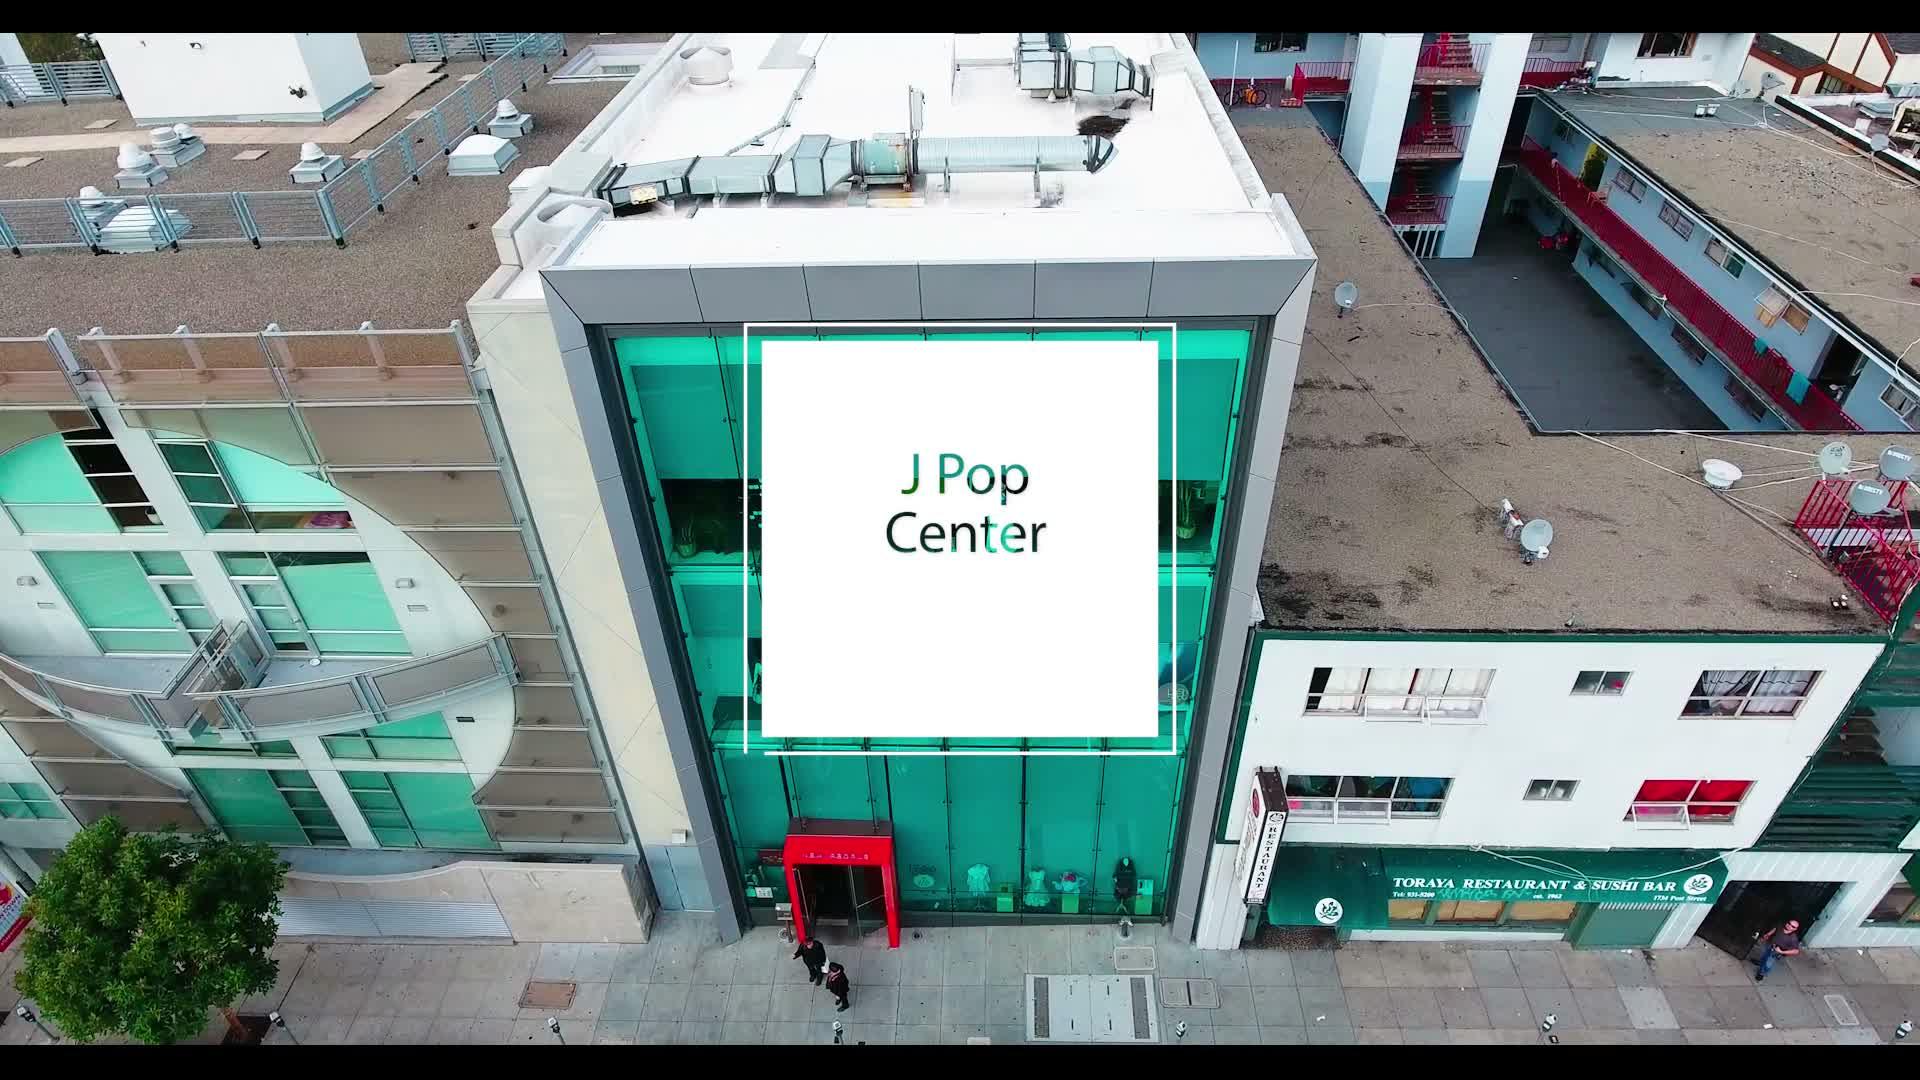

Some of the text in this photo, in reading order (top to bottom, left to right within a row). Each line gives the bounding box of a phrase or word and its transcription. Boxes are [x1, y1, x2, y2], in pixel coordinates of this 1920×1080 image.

[1256, 827, 1277, 888] RESTAURANT
[1393, 877, 1677, 892] TORAYA RESTAURANT & SUSHI BAR
